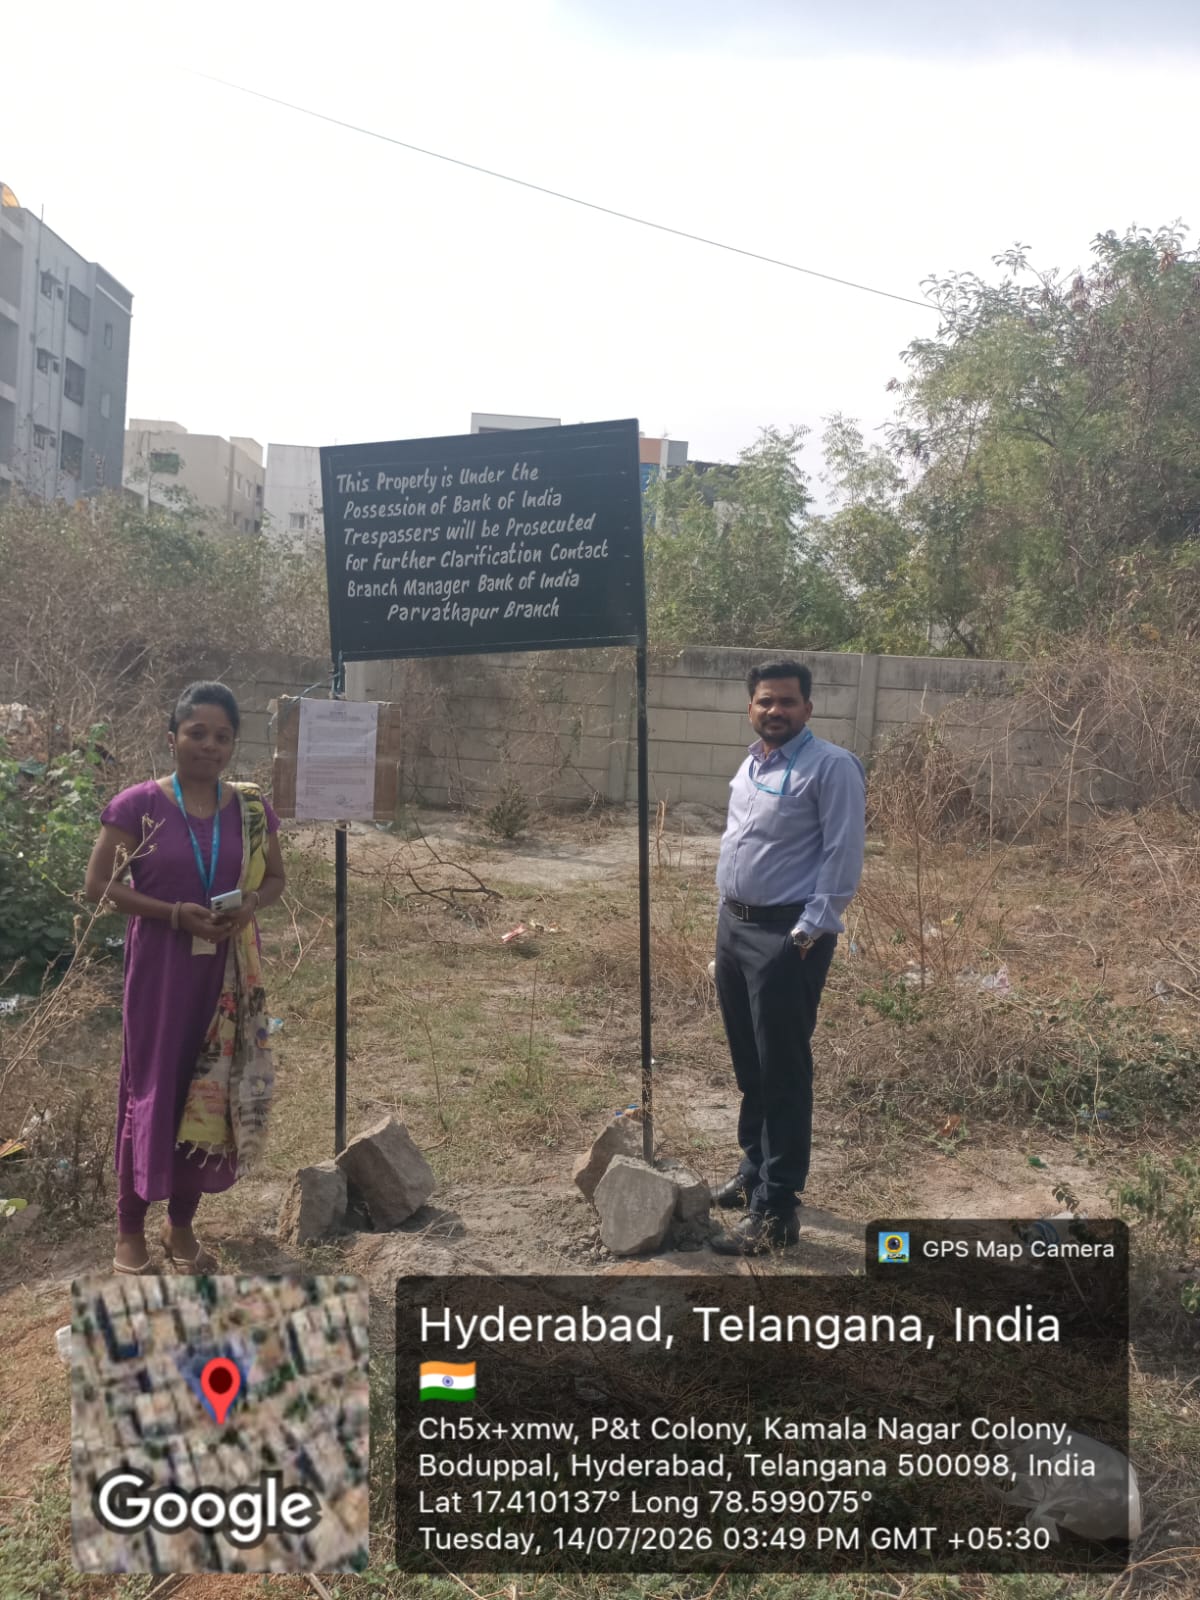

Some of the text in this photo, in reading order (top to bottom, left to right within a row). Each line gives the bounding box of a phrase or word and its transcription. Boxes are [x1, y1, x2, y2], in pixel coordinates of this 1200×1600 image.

[336, 462, 539, 494] This Property is Under the
[343, 487, 562, 520] Possession of Bank of India
[343, 512, 597, 549] Trespassers will be Prosecuted
[440, 541, 542, 568] Clarification
[550, 538, 609, 561] Contact
[347, 568, 580, 602] Branch Manager Bank of India
[387, 597, 560, 627] Parvathapur Branch
